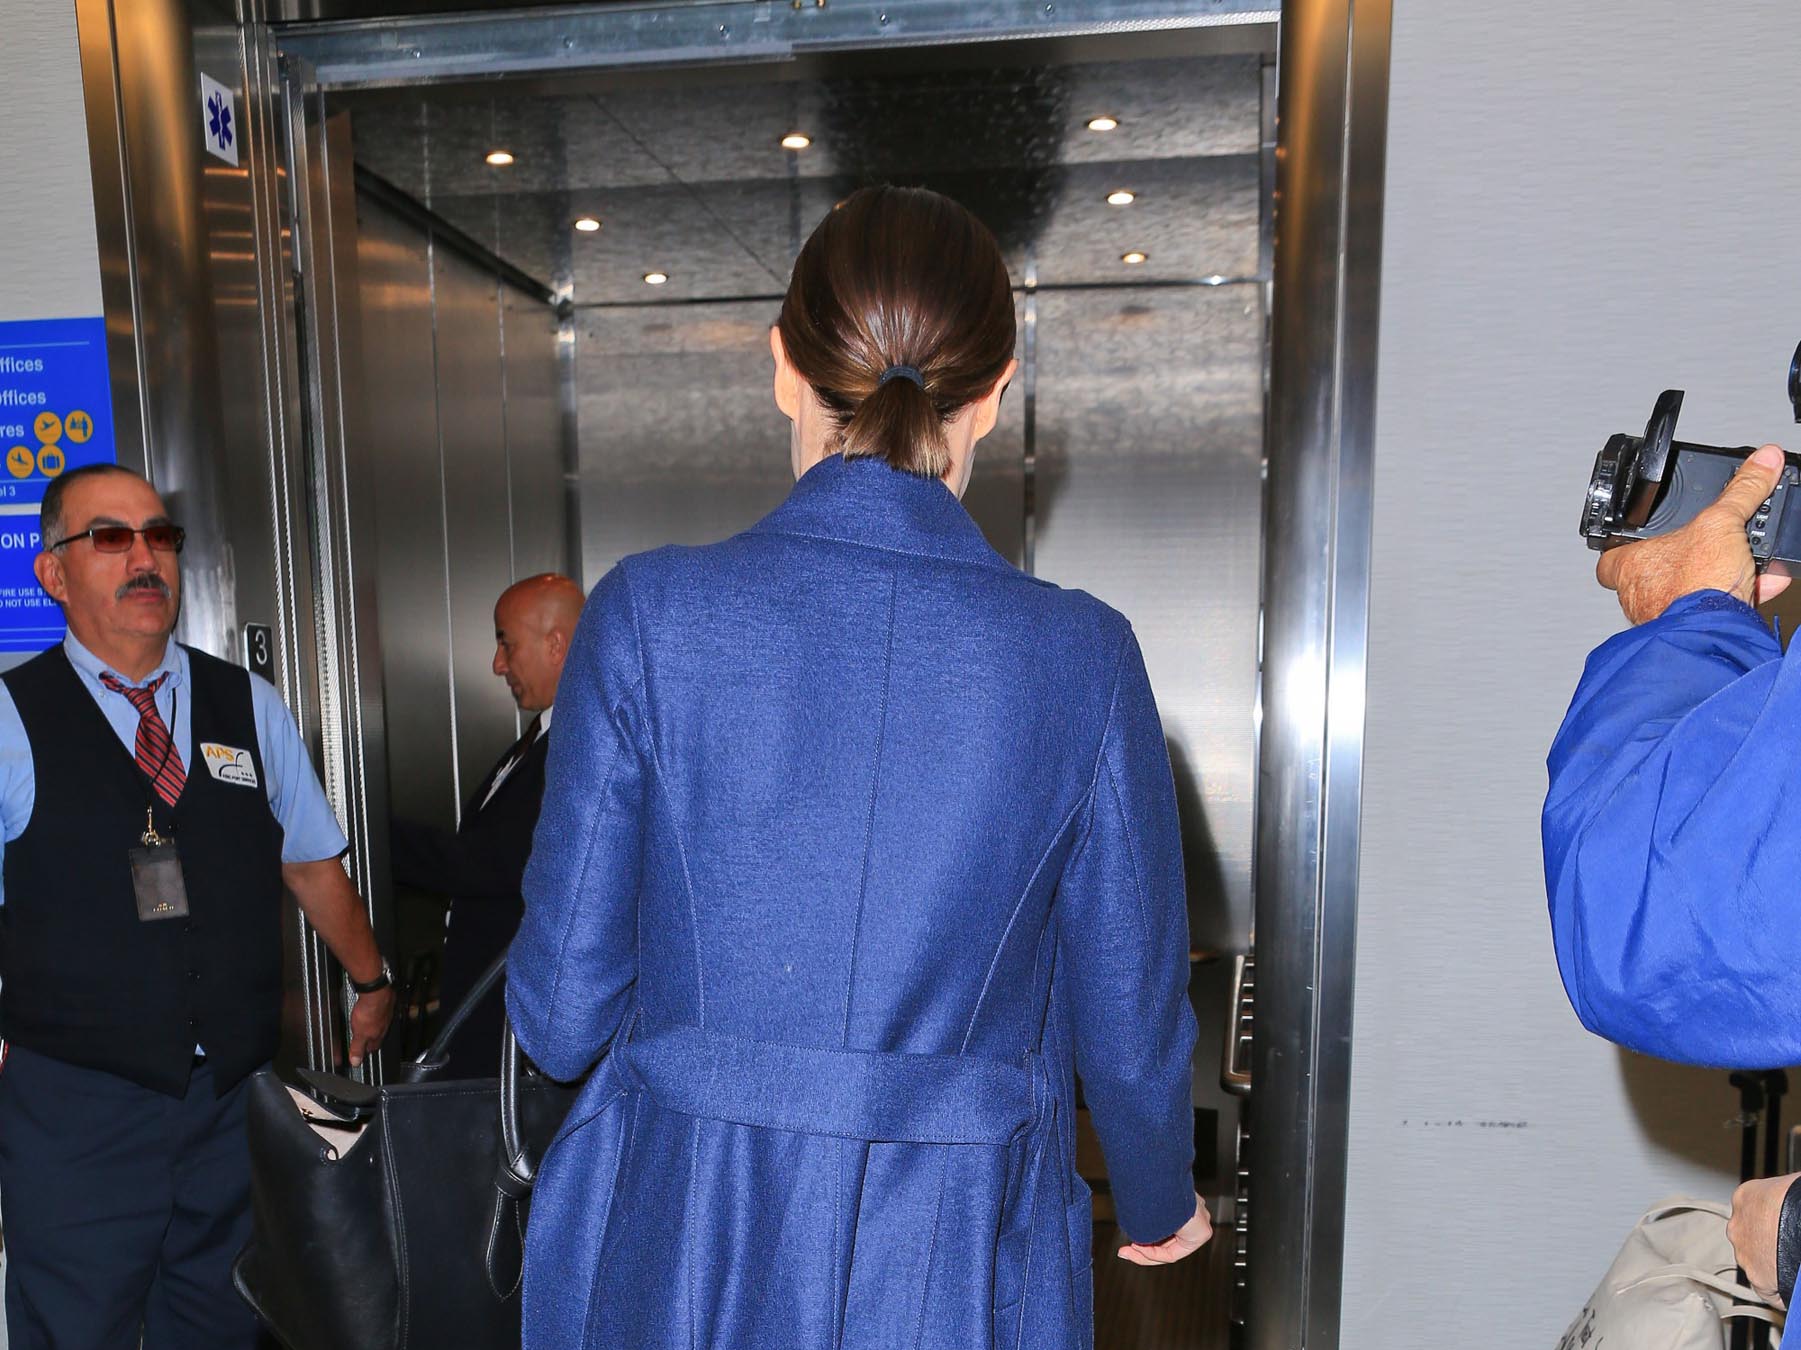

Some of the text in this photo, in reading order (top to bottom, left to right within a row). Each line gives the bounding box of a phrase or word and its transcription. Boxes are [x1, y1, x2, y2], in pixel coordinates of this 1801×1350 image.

[9, 485, 16, 497] 3
[0, 532, 25, 549] ON
[18, 588, 35, 597] USE
[5, 599, 21, 607] NOT
[24, 598, 41, 607] USE
[255, 630, 268, 666] 3
[206, 745, 235, 762] APS
